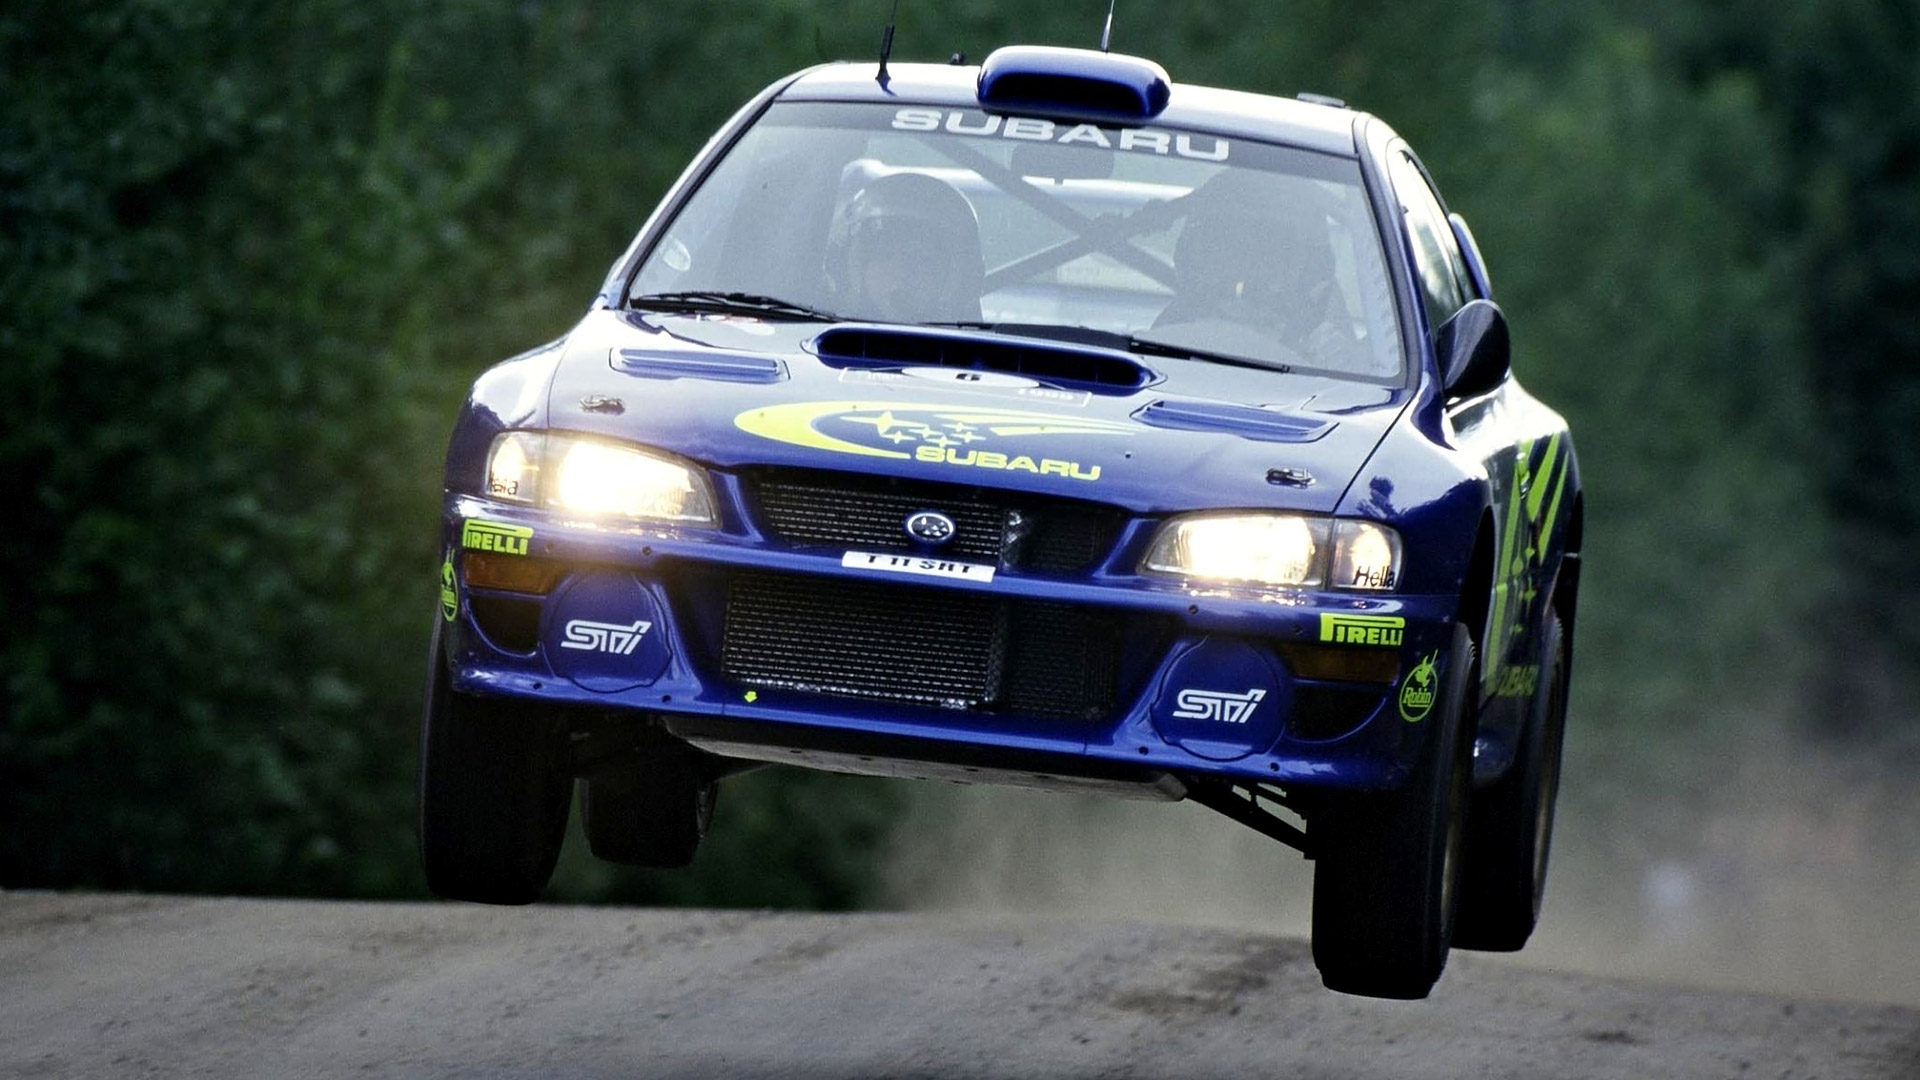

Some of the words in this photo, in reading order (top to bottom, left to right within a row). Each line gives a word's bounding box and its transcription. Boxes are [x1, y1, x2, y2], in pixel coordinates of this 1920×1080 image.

[892, 108, 1230, 162] SUBARU
[915, 446, 1102, 481] SUBARU
[462, 518, 534, 555] PIRELLI
[1352, 565, 1396, 588] Hella
[1320, 612, 1406, 646] PIRELLI
[1402, 686, 1432, 705] Robin
